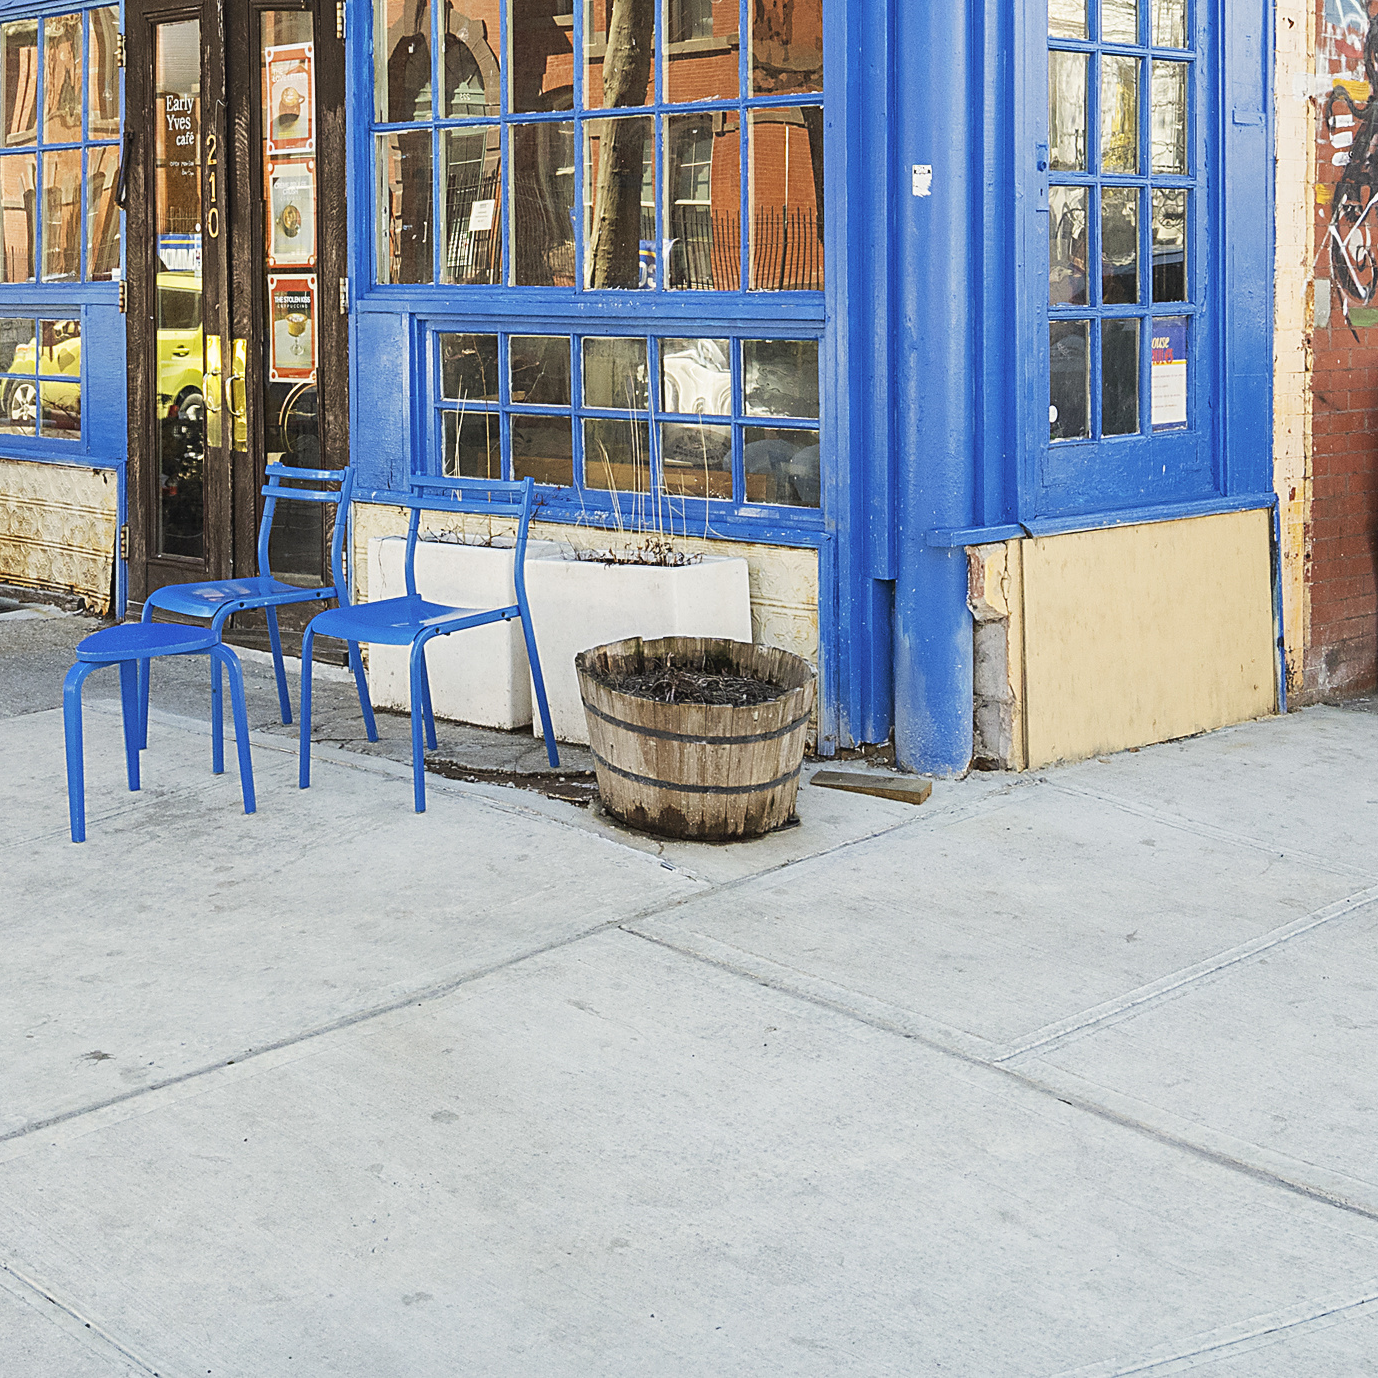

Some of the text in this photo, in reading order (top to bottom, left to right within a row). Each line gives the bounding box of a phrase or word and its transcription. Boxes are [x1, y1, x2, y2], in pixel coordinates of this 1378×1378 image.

[165, 93, 195, 114] Early
[165, 114, 192, 131] Yves
[175, 132, 195, 146] café
